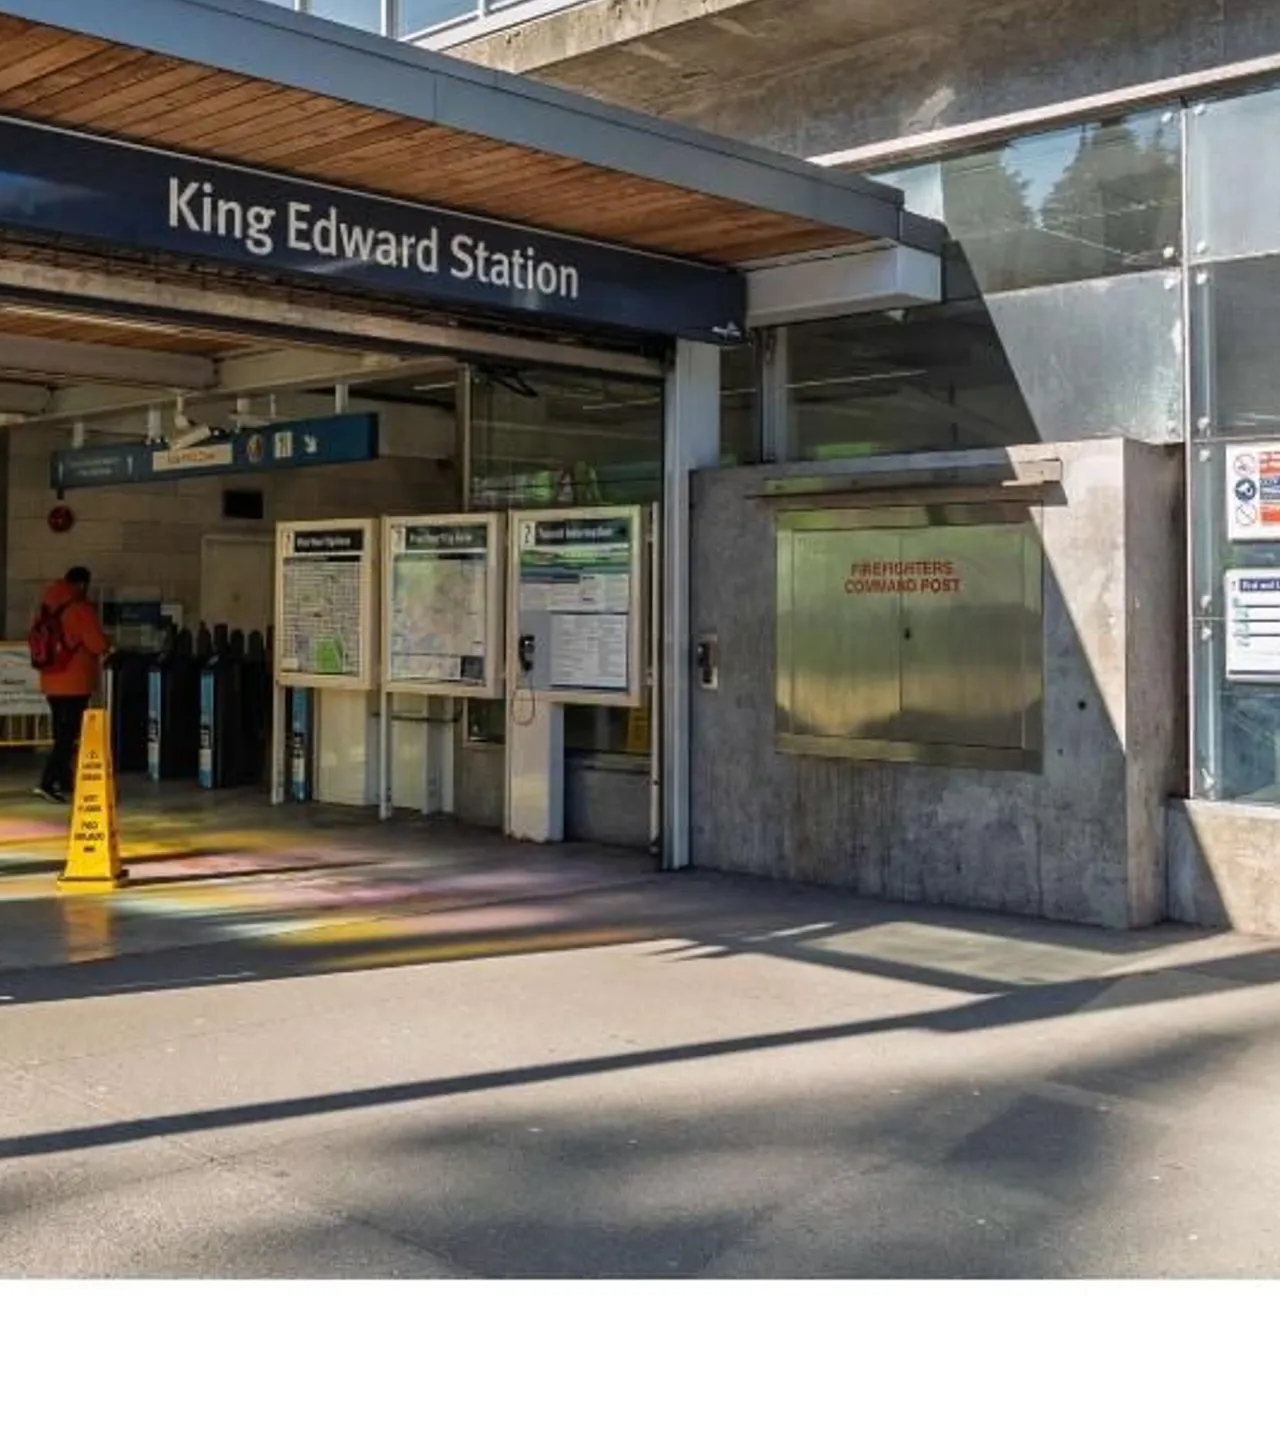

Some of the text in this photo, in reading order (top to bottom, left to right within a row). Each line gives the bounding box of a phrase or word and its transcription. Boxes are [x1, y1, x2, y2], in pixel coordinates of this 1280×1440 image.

[167, 176, 580, 299] King Edward Station
[844, 578, 961, 594] COMMAND POST
